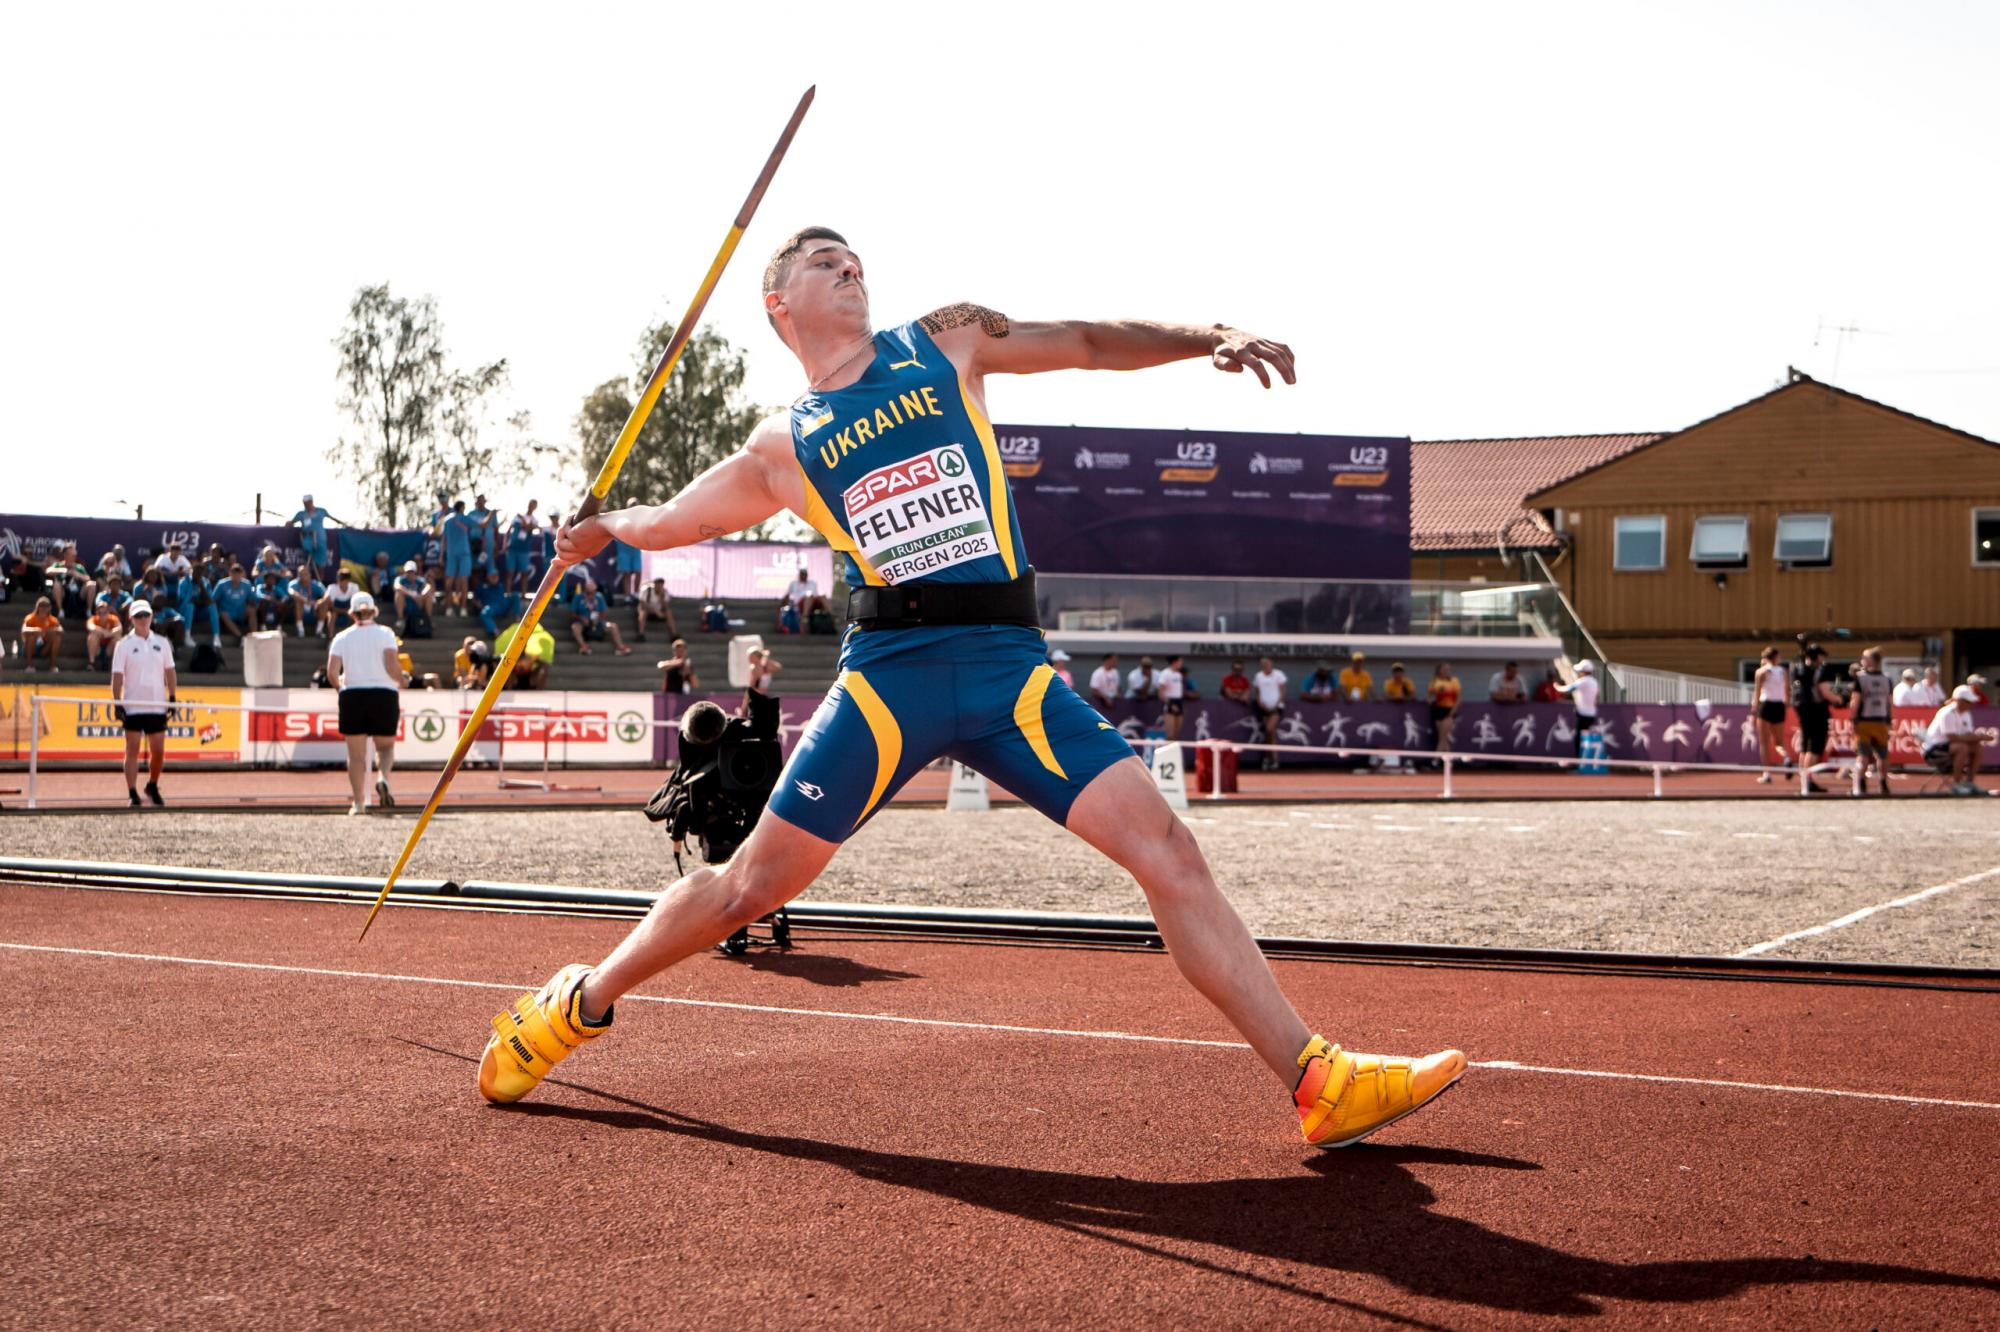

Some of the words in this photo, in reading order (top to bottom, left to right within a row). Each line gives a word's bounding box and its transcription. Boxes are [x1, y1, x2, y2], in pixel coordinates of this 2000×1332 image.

[819, 386, 943, 470] UKRAINE
[1001, 436, 1040, 454] U23
[1177, 442, 1216, 460] U23
[1350, 446, 1388, 464] U23
[848, 459, 936, 513] SPAR
[854, 483, 981, 548] FELFNER
[161, 530, 200, 550] U23
[890, 548, 897, 558] I
[898, 539, 924, 556] RUN
[772, 551, 808, 568] U23
[882, 548, 950, 581] BERGEN
[951, 537, 988, 559] 2025
[493, 714, 607, 738] SPAR
[1158, 761, 1175, 780] 12
[509, 1035, 534, 1064] PUMA
